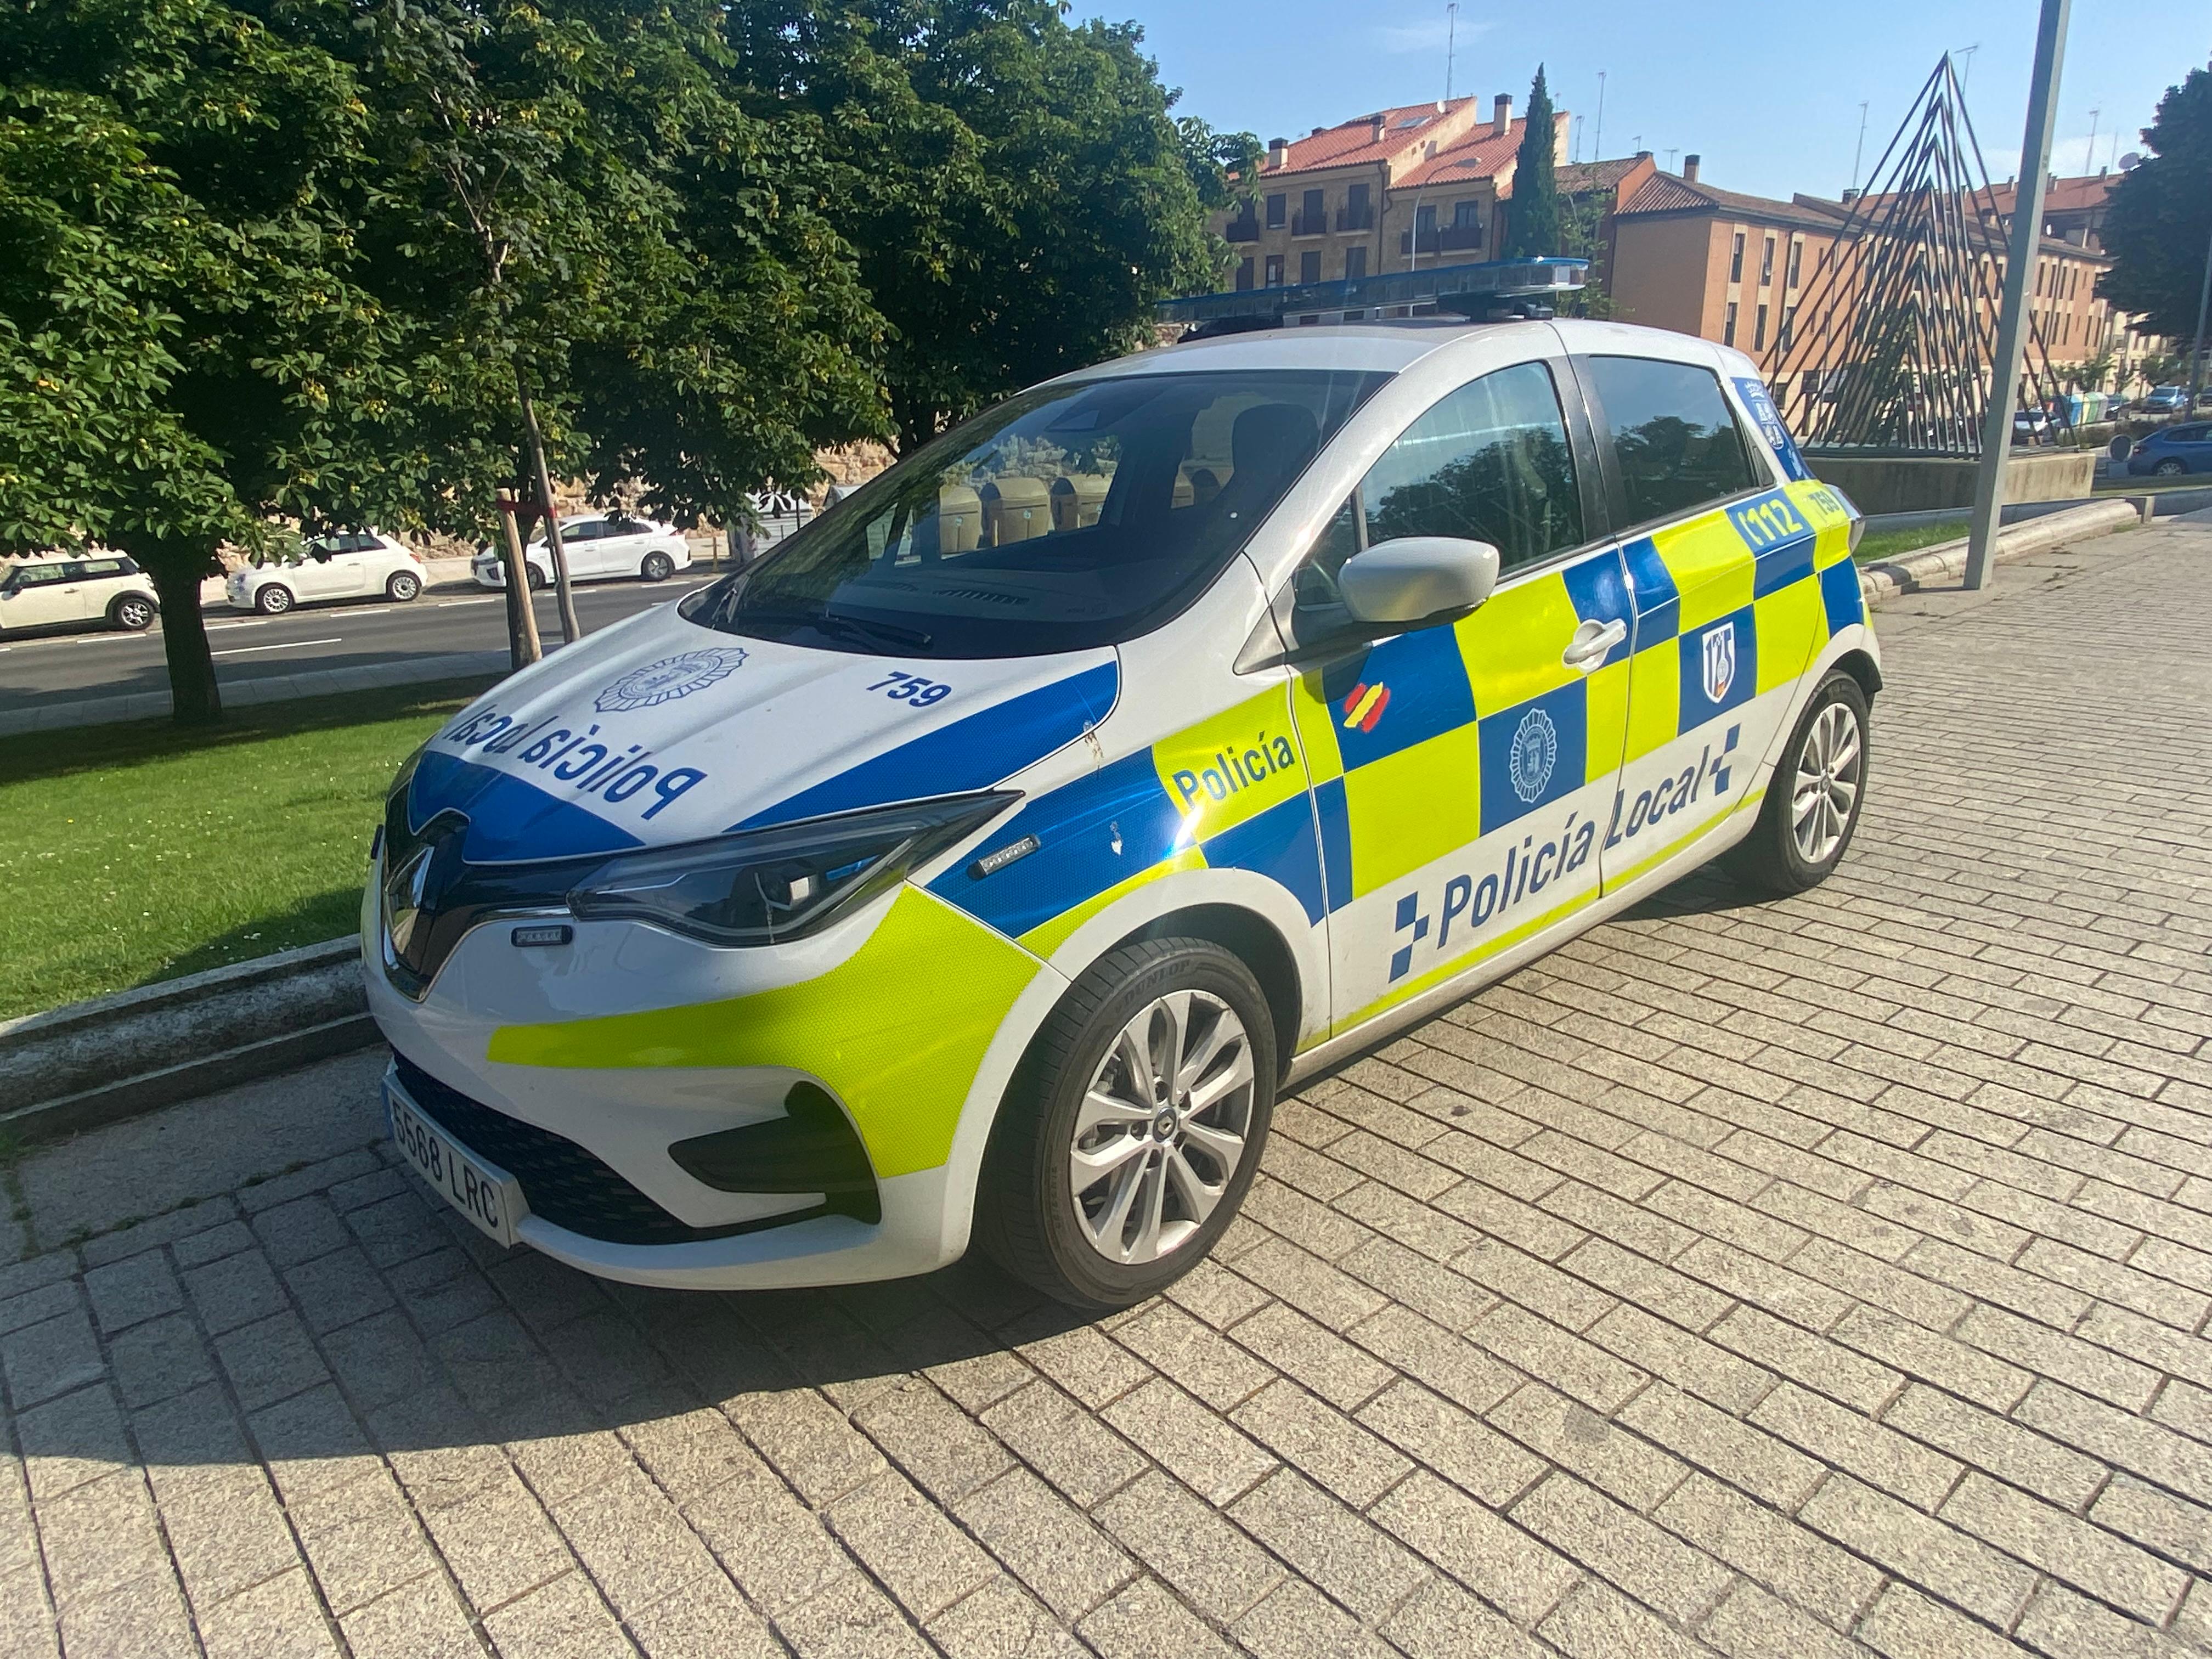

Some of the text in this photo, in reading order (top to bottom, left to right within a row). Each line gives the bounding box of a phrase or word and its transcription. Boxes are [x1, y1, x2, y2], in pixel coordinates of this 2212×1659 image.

[1746, 499, 1803, 541] 112
[1808, 490, 1840, 515] 759
[866, 671, 951, 708] 759
[1171, 730, 1295, 810] Policía
[1437, 810, 1595, 950] Policía
[1604, 744, 1711, 851] Local
[392, 1099, 499, 1229] 5568 LRC
